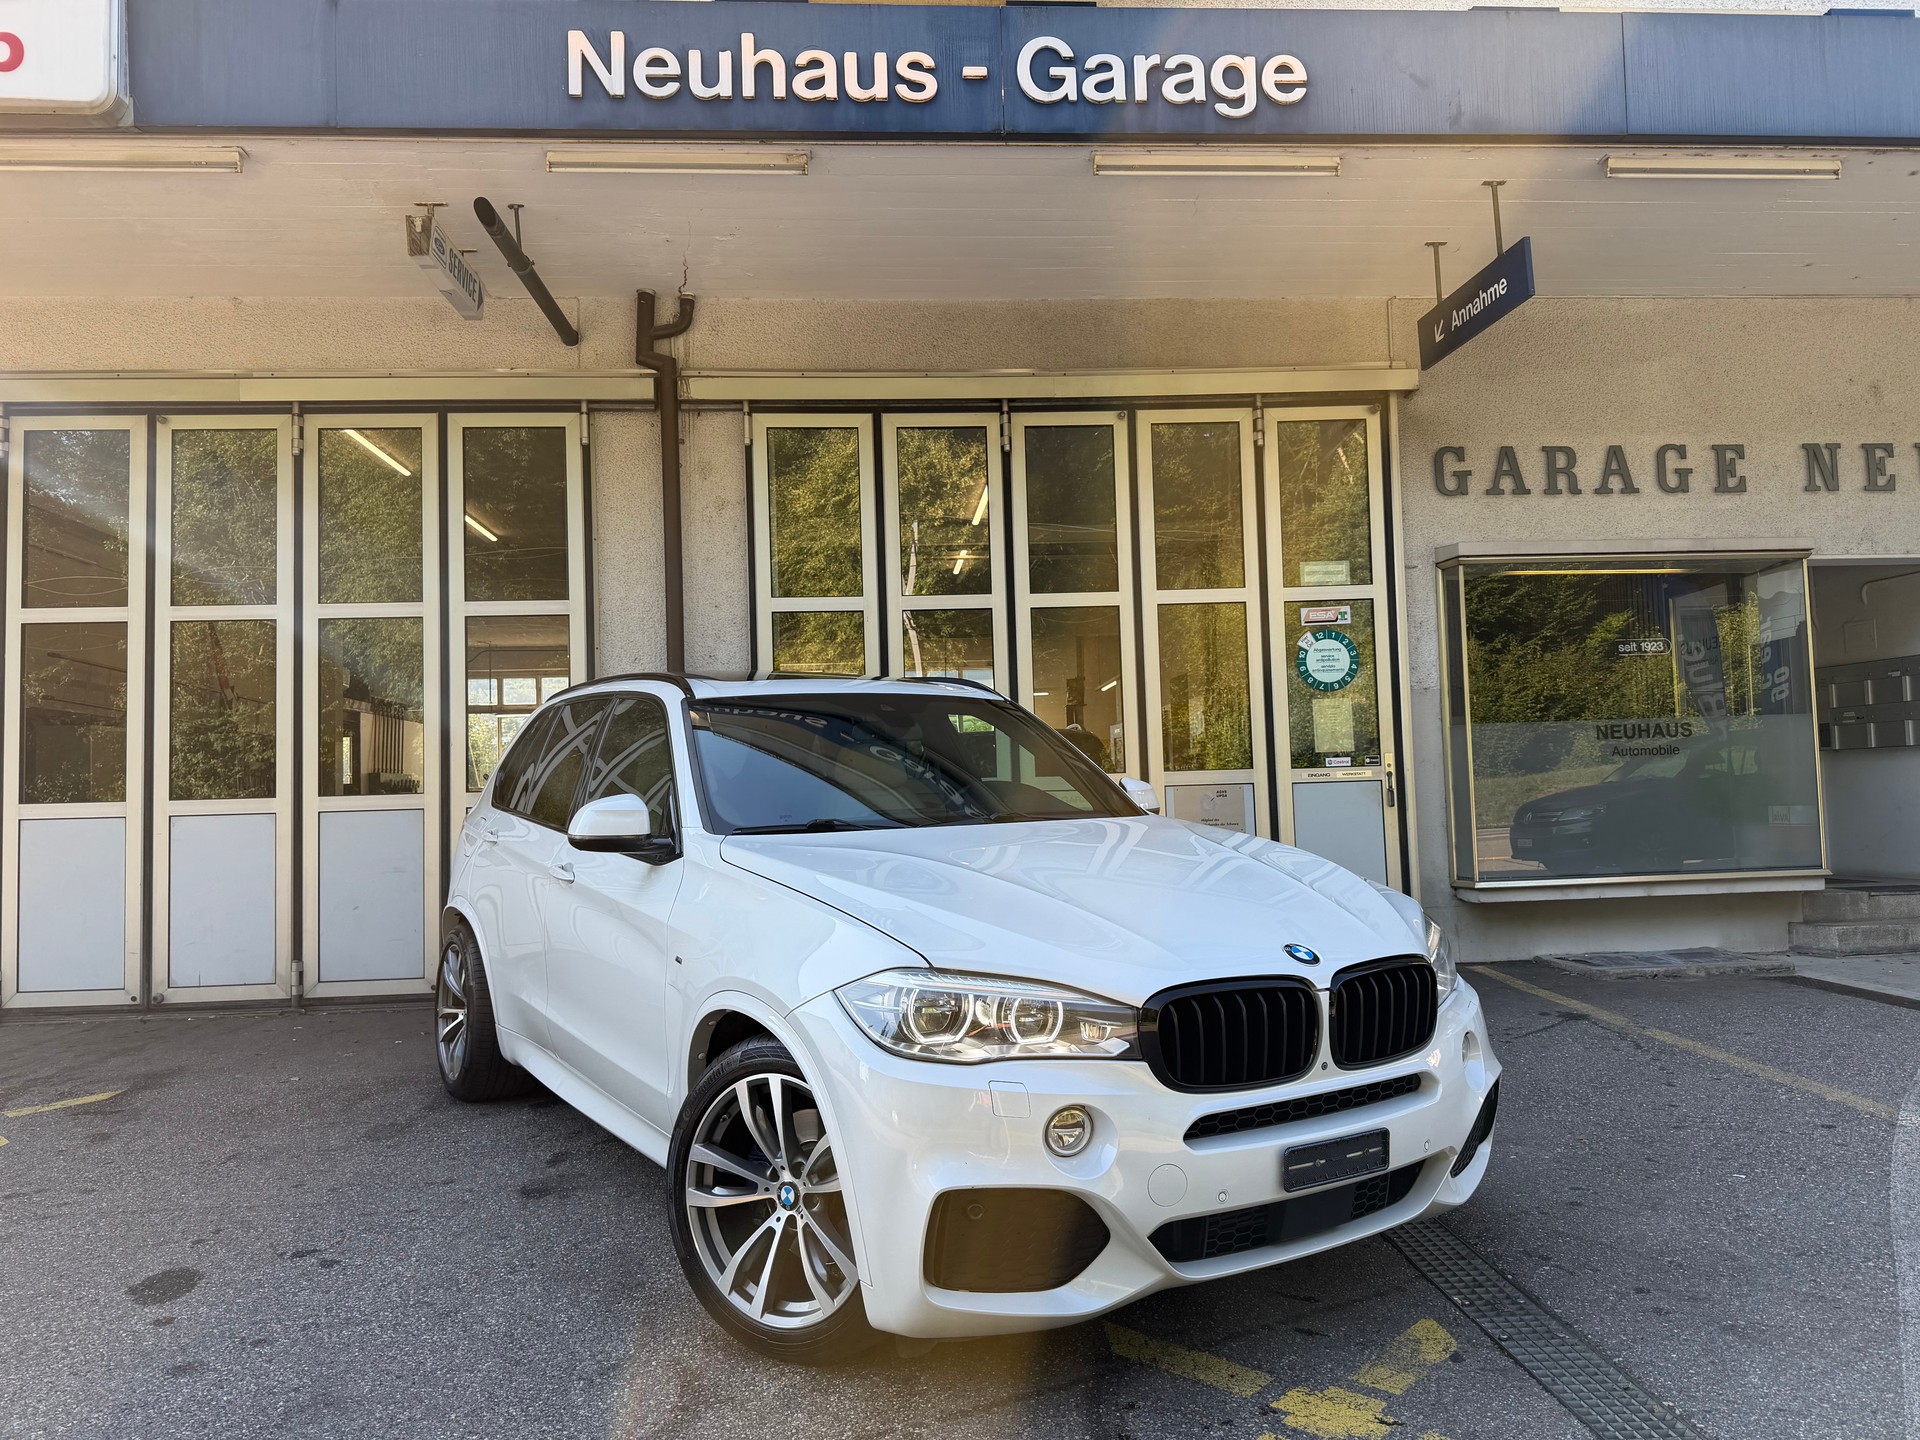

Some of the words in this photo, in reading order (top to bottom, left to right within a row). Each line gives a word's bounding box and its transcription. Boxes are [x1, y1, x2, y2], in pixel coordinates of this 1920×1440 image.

[567, 30, 938, 103] Neuhaus
[1016, 36, 1309, 119] Garage
[448, 248, 477, 302] SERVICE
[1452, 278, 1508, 332] Annahme
[1434, 444, 1747, 496] GARAGE
[1802, 442, 1920, 492] NE
[1310, 610, 1335, 619] ESA
[1618, 643, 1637, 652] seit
[1640, 642, 1664, 651] 1923
[1596, 722, 1693, 740] NEUHAUS
[1612, 745, 1680, 756] Automobile
